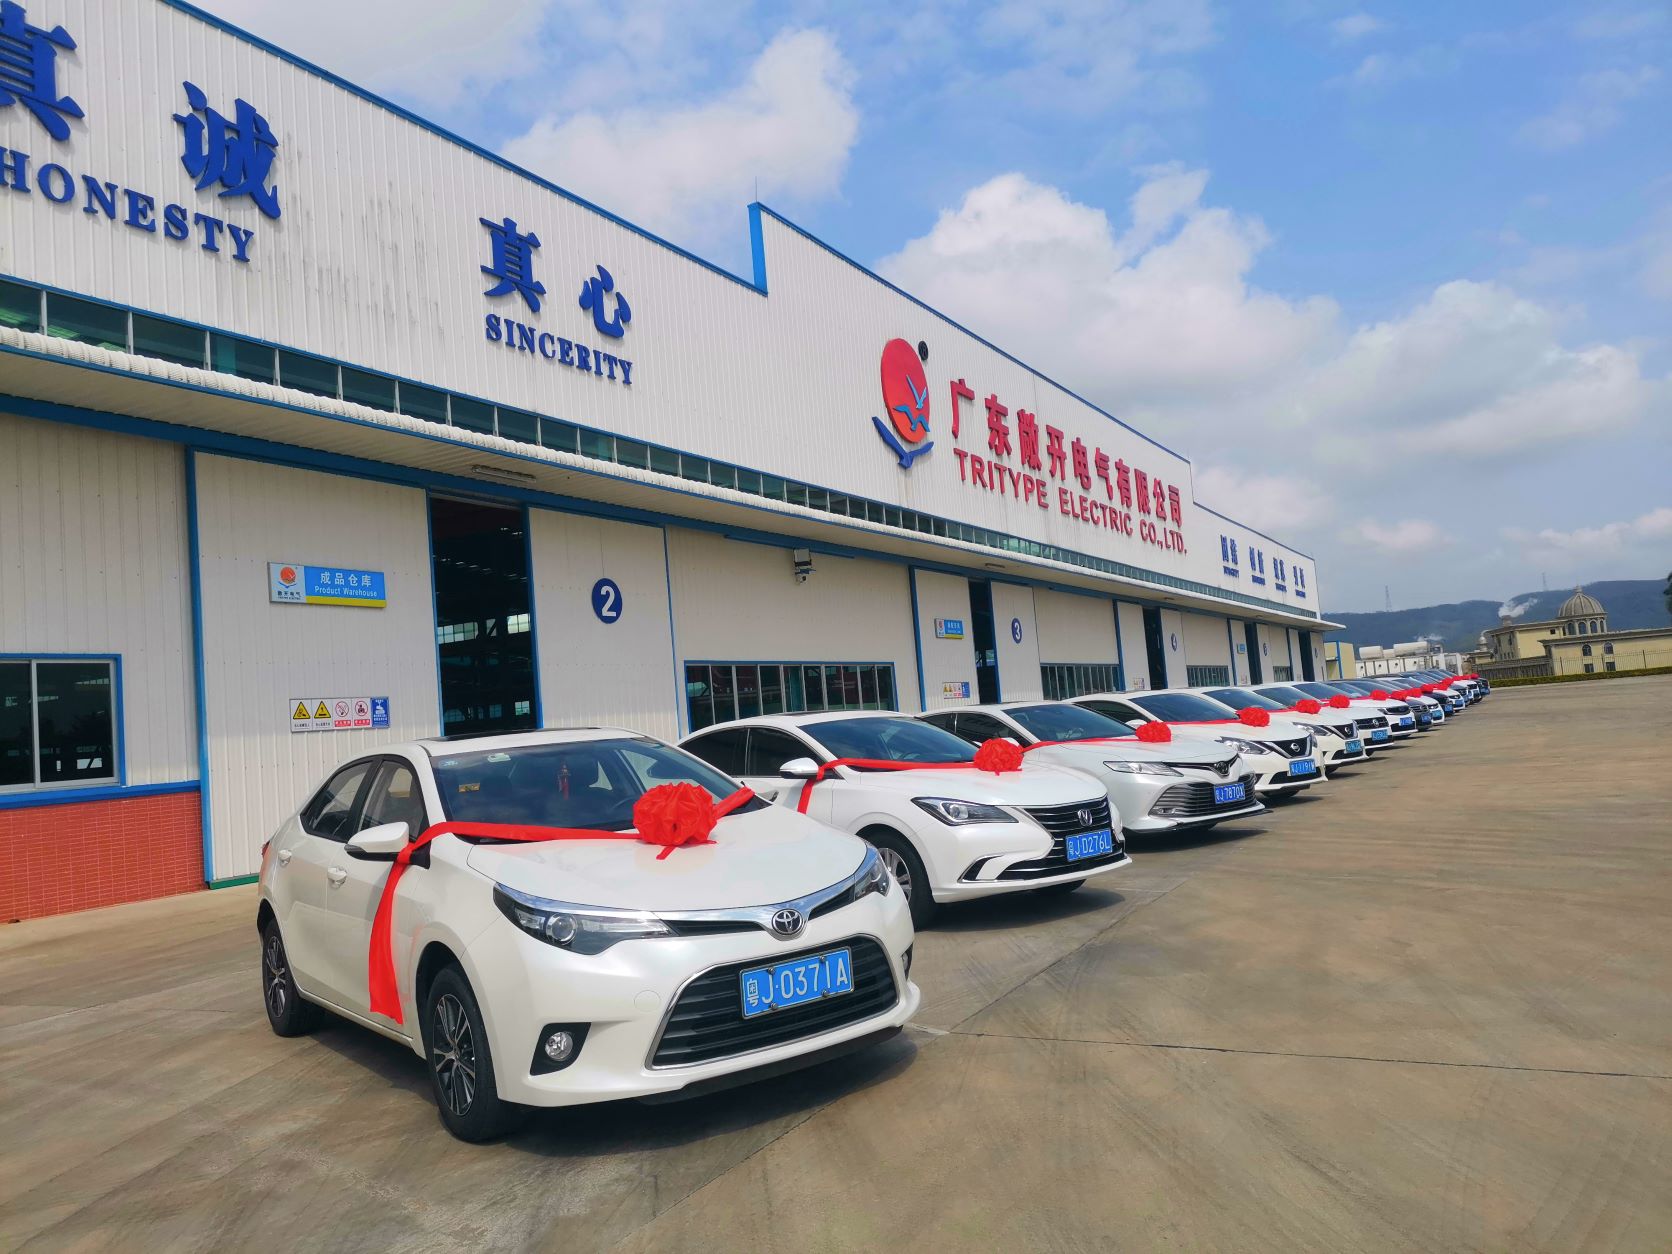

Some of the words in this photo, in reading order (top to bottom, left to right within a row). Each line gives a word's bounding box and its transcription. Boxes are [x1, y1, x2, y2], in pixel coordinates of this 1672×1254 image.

[0, 145, 254, 262] HONESTY
[479, 217, 631, 338] 真心
[486, 313, 633, 385] SINCERITY
[950, 378, 1183, 528] 广东敞开电气有限公司
[953, 447, 1049, 509] TRITYPE
[1058, 486, 1133, 537] ELECTRIC
[314, 585, 341, 595] Product
[342, 587, 378, 597] Warehouse
[320, 571, 372, 587] 成品仓库
[600, 585, 617, 617] 2
[1014, 622, 1021, 640] 3
